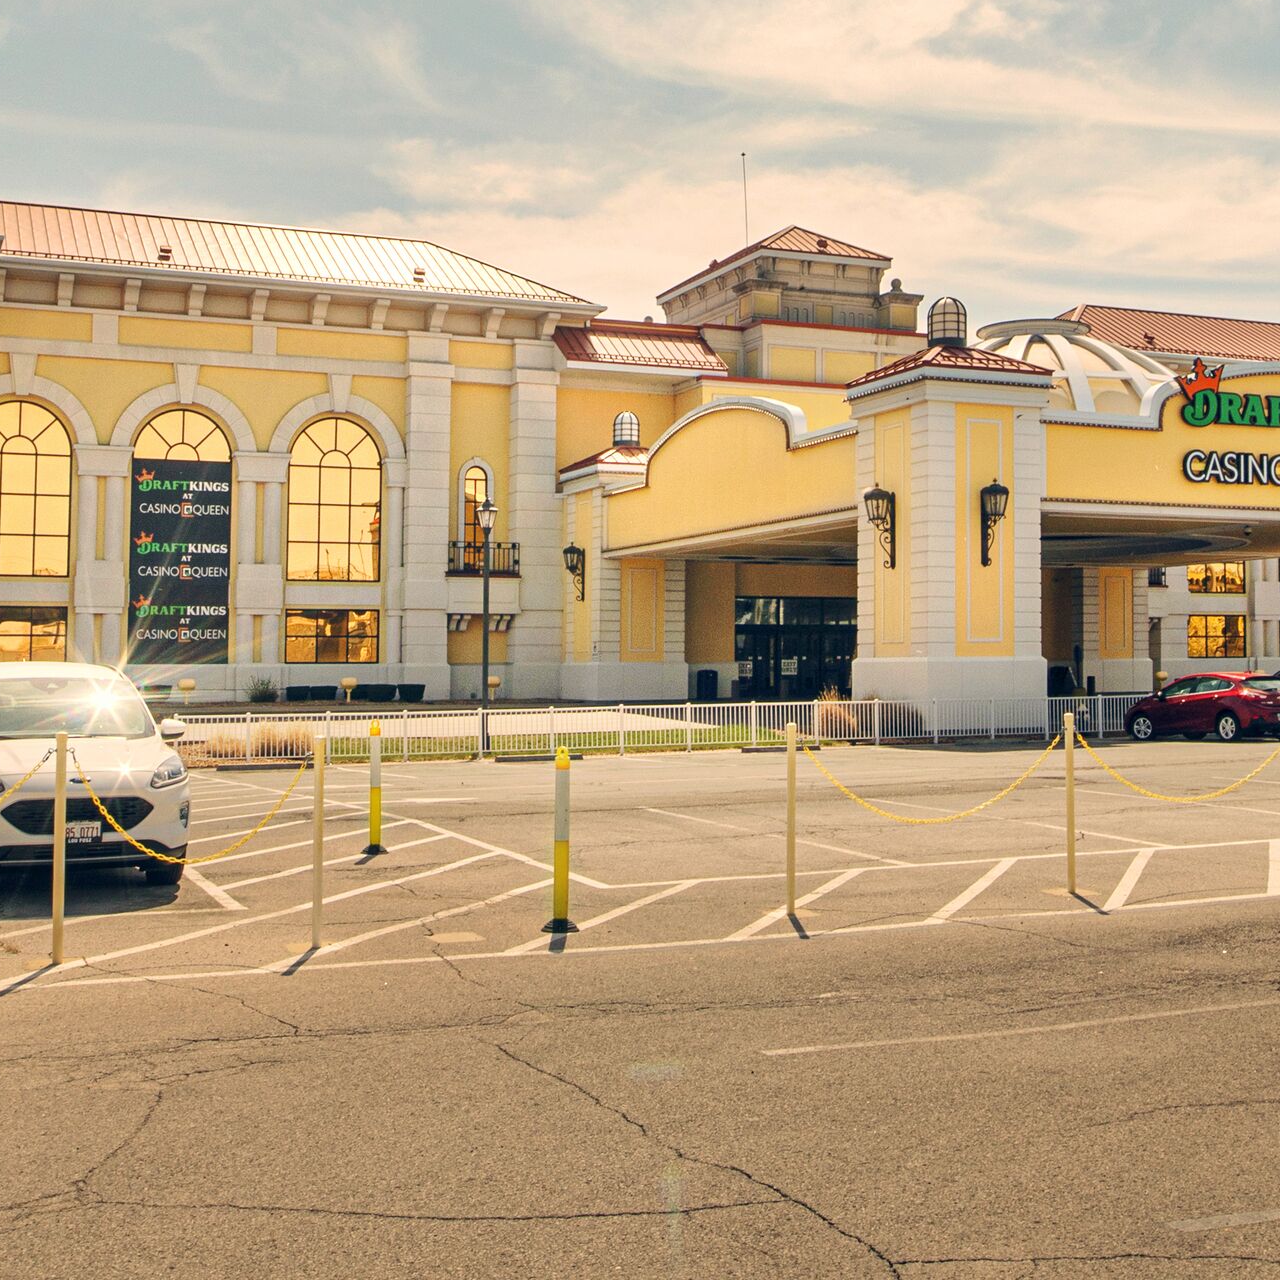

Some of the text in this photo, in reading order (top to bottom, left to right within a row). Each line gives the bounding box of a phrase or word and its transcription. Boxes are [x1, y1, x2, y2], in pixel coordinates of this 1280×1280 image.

[138, 479, 230, 492] DRAFTKINGS
[139, 502, 230, 516] CASINO QUEEN
[137, 542, 228, 555] DRAFTKINGS
[138, 565, 228, 579] CASINO QUEEN
[136, 604, 227, 618] DRAFTKINGS
[136, 628, 226, 641] CASINO QUEEN
